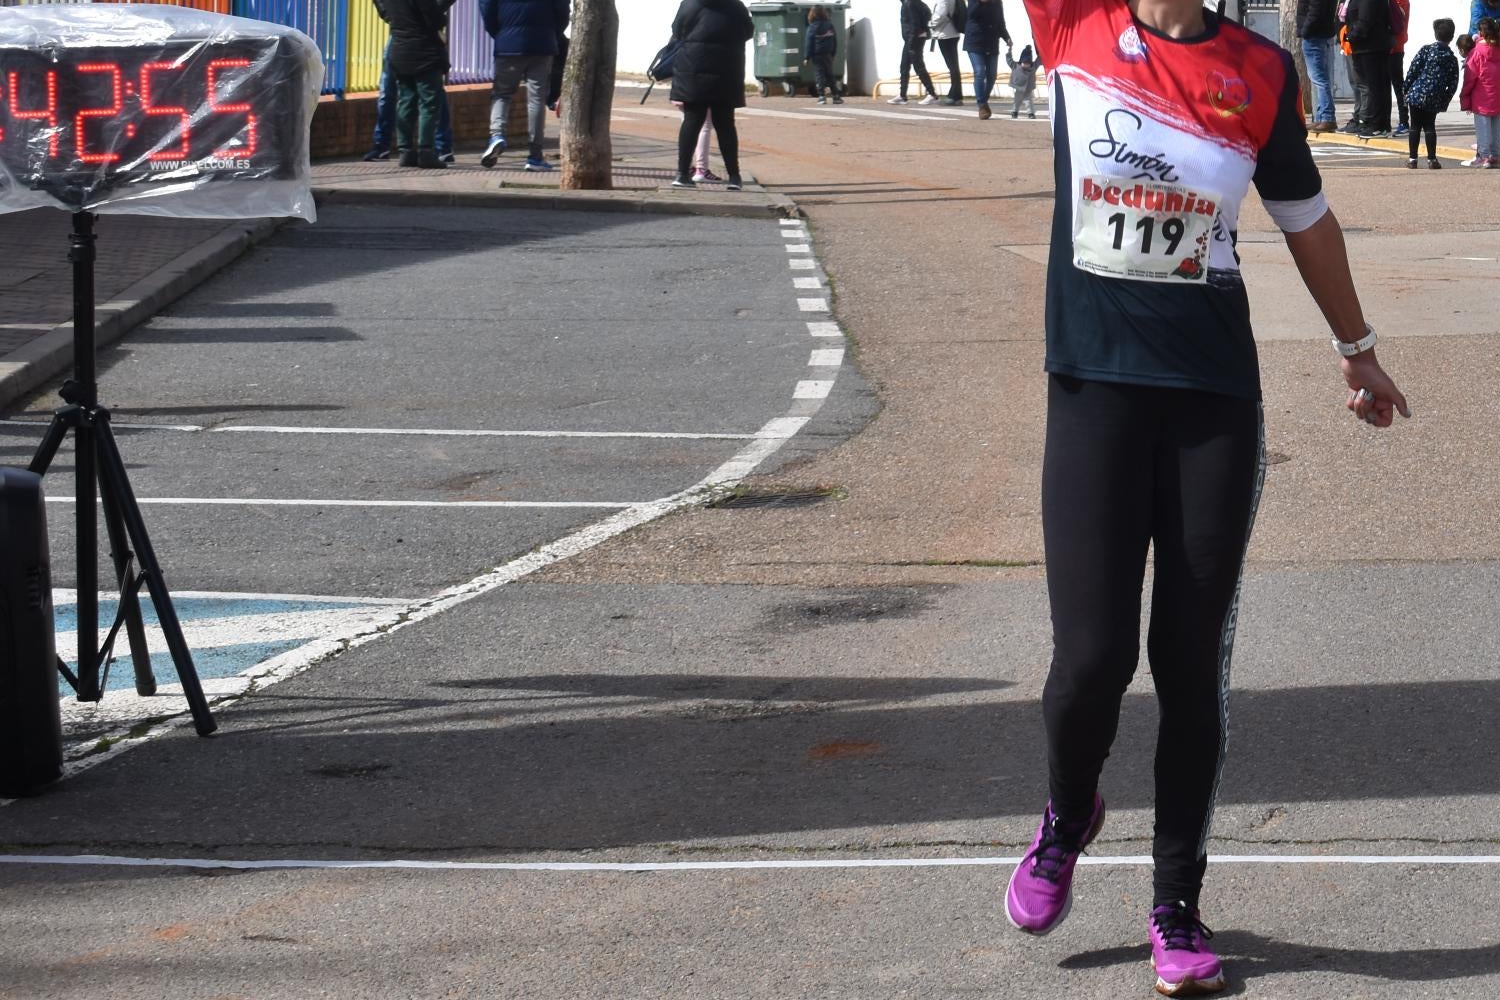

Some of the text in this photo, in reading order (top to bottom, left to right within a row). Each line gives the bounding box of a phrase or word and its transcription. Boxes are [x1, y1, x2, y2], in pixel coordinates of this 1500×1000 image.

[150, 159, 250, 171] WWWPIELCOM.ES
[1088, 108, 1179, 182] Simón
[1083, 177, 1216, 217] bedunia
[1108, 212, 1185, 256] 119
